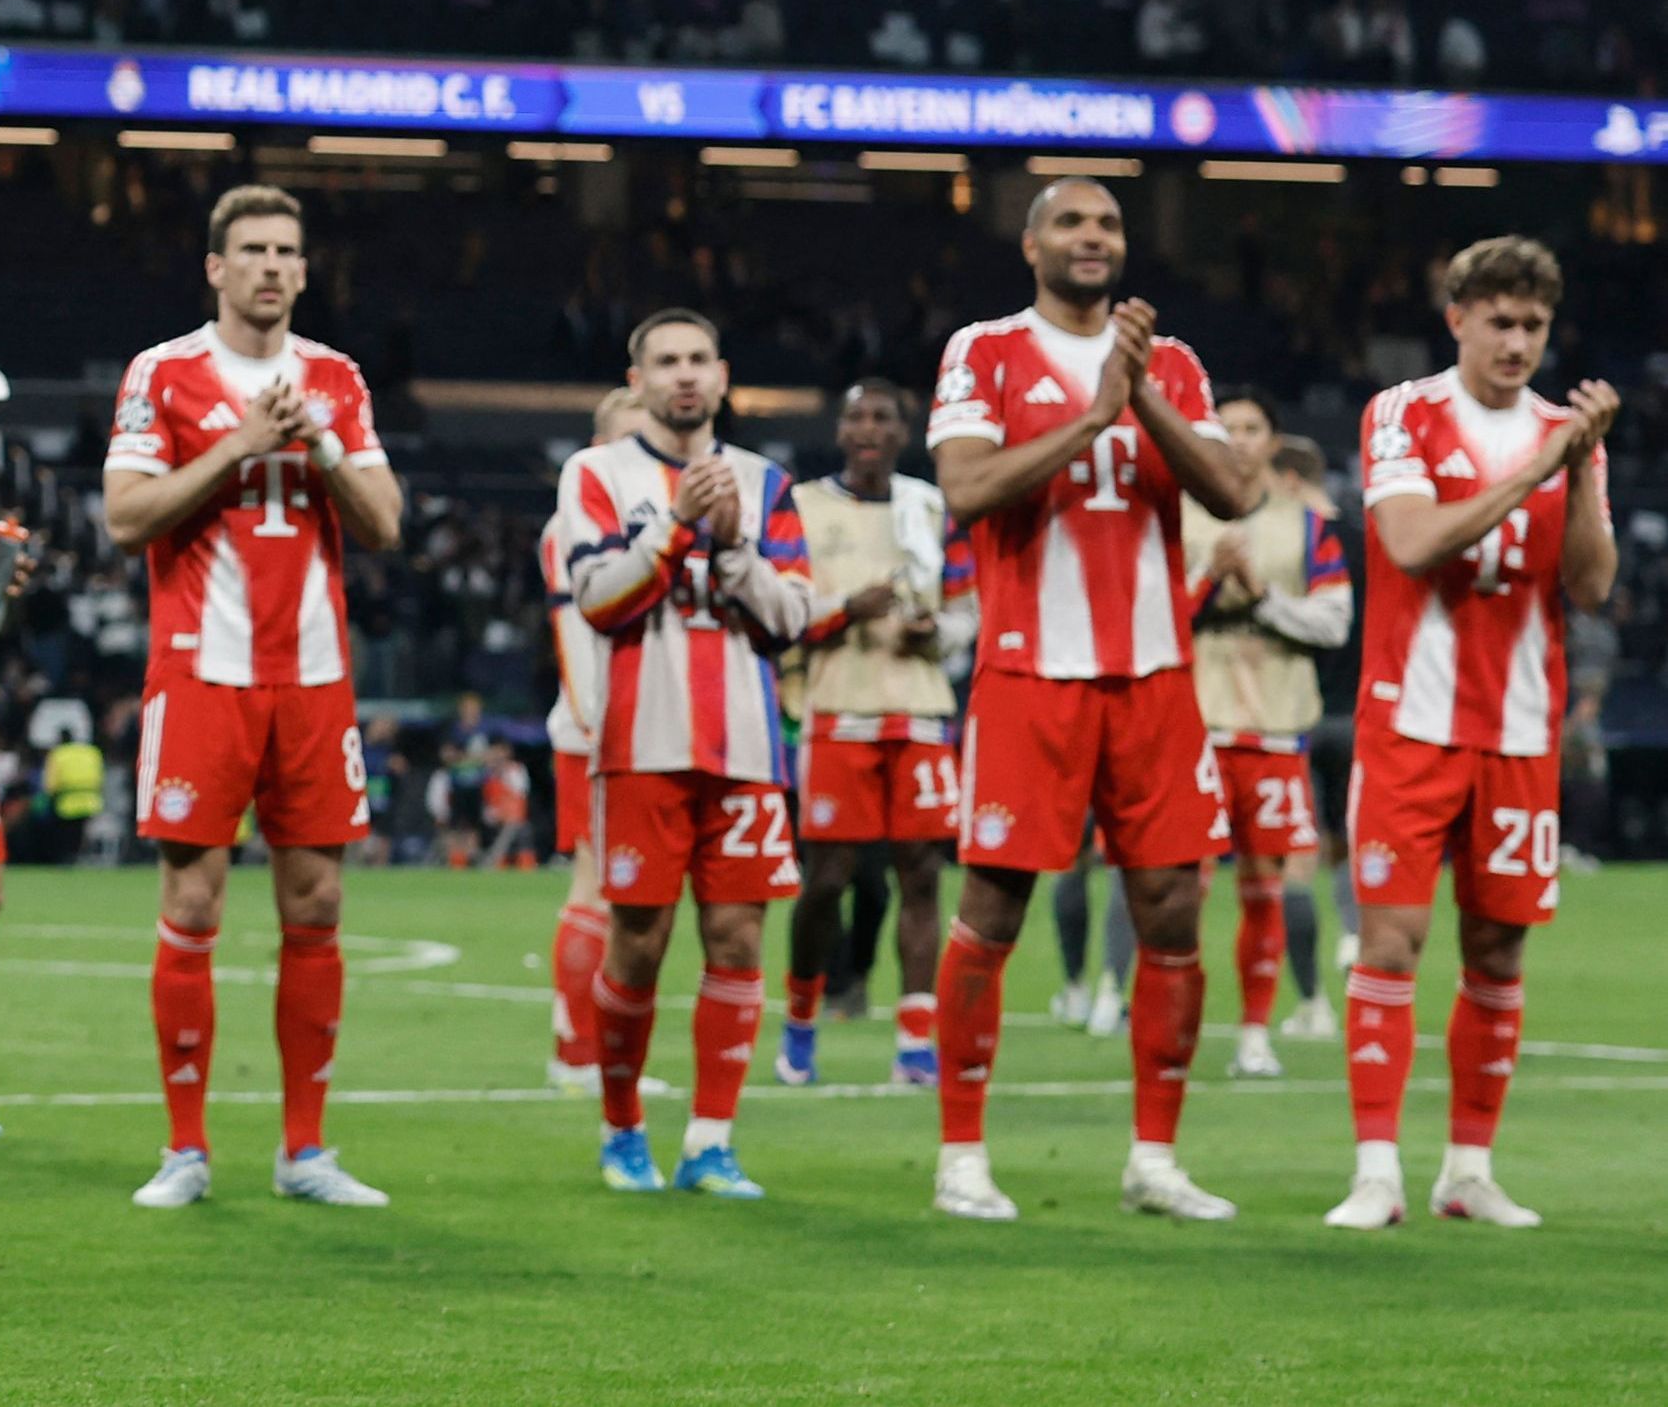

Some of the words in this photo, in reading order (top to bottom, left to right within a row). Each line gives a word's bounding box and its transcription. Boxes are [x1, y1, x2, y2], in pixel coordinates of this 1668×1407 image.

[187, 64, 284, 113] REAL
[288, 68, 440, 118] MADRID
[637, 82, 685, 125] VS
[782, 82, 832, 130] FC
[835, 85, 970, 135] BAYERN
[974, 81, 1153, 141] MÜNCHEN
[240, 451, 310, 537] T
[1070, 425, 1136, 513] T
[341, 725, 367, 792] 8
[913, 759, 959, 809] 11
[720, 791, 792, 857] 22
[1256, 776, 1307, 829] 21
[1488, 807, 1559, 878] 20
